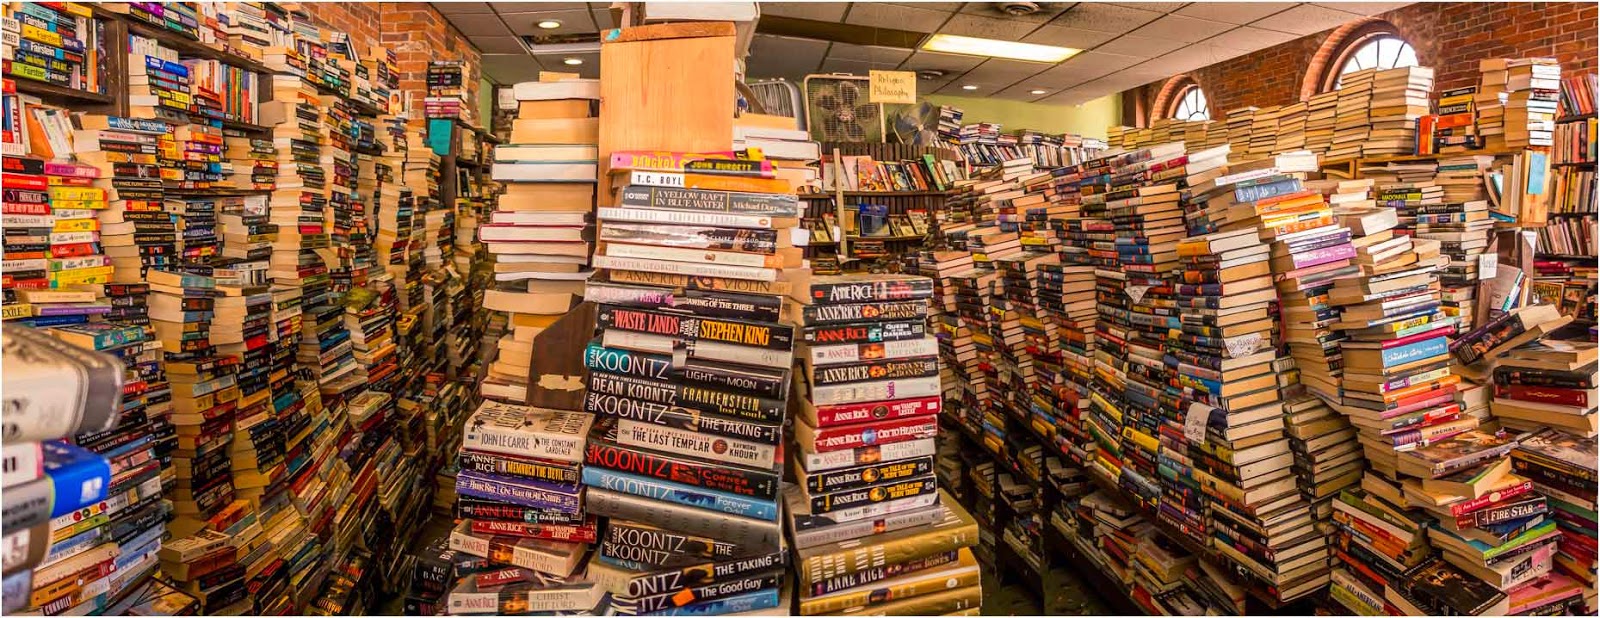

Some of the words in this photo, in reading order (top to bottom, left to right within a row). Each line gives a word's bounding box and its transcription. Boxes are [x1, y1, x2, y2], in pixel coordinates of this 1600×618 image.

[632, 155, 675, 168] BANGKOK
[715, 162, 752, 171] BURDETT
[637, 175, 656, 184] T.C.
[663, 191, 699, 201] YELLOW
[701, 193, 726, 201] RAFT
[655, 198, 665, 206] IN
[668, 198, 691, 208] BLUE
[692, 199, 724, 209] WATER
[733, 202, 758, 211] Michael
[625, 272, 655, 284] ANNE
[661, 274, 689, 285] RICE
[724, 279, 770, 292] VIOLIN
[640, 295, 661, 303] KING
[851, 285, 872, 300] RICE
[709, 300, 718, 309] OF
[718, 301, 733, 310] THE
[733, 303, 755, 312] THREE
[816, 305, 841, 321] ANNE
[841, 305, 862, 319] RICE
[614, 310, 647, 330] WASTE
[648, 315, 679, 335] LANDS
[701, 320, 743, 342] STEPHEN
[744, 326, 769, 346] KING
[817, 330, 845, 342] ANNE
[845, 327, 868, 340] RICE
[589, 350, 598, 367] DEAN
[596, 351, 671, 381] KOONTZ
[685, 370, 713, 382] LIGHT
[727, 377, 757, 390] MOON
[823, 369, 848, 383] ANNE
[849, 366, 869, 380] RICE
[592, 378, 623, 395] DEAN
[628, 384, 676, 405] KOONTZ
[683, 388, 760, 411] FRANKENSTEIN
[588, 393, 596, 411] DEAN
[594, 394, 669, 425] KOONTZ
[719, 405, 736, 415] lost
[740, 410, 767, 419] souls
[834, 412, 852, 421] ANNE
[853, 408, 869, 418] RICE
[701, 417, 719, 431] THE
[723, 420, 762, 438] TAKING
[481, 434, 498, 446] JOHN
[500, 435, 505, 447] LE
[541, 438, 551, 446] THE
[552, 440, 576, 448] CONSTANT
[632, 430, 647, 443] THE
[648, 432, 669, 447] LAST
[671, 436, 709, 453] TEMPLAR
[733, 442, 757, 451] RAYMOND
[826, 435, 846, 447] ANNE
[847, 433, 861, 444] RICE
[545, 446, 571, 455] GARDENER
[730, 449, 759, 461] KHOURY
[470, 454, 496, 464] ANNE
[593, 444, 670, 478] KOONTZ
[475, 463, 495, 472] RICE
[549, 468, 564, 481] DEVIL
[826, 475, 845, 486] ANNE
[846, 473, 861, 482] RICE
[606, 475, 671, 500] KOONTZ
[717, 496, 752, 510] Forever
[833, 495, 850, 505] ANNE
[851, 492, 868, 501] RICE
[474, 505, 501, 516] ANNE
[501, 506, 523, 519] RICE
[1491, 510, 1510, 521] FIRE
[1511, 504, 1534, 516] STAR
[489, 521, 506, 531] ANNE
[506, 523, 522, 532] RICE
[617, 527, 686, 553] KOONTZ
[612, 544, 670, 566] KOONTZ
[715, 544, 732, 556] THE
[715, 566, 734, 576] THE
[737, 556, 772, 571] TAKING
[423, 570, 445, 582] BAC
[498, 569, 520, 580] ANNE
[827, 575, 855, 592] ANNE
[860, 568, 884, 584] RICE
[628, 571, 684, 598] ONTZ
[701, 587, 717, 598] The
[719, 582, 742, 594] Good
[744, 579, 762, 590] Guy
[536, 592, 571, 600] CHRIST
[465, 600, 482, 609] ANNE
[482, 601, 495, 609] RICE
[532, 600, 550, 609] THE
[551, 600, 576, 609] LORD
